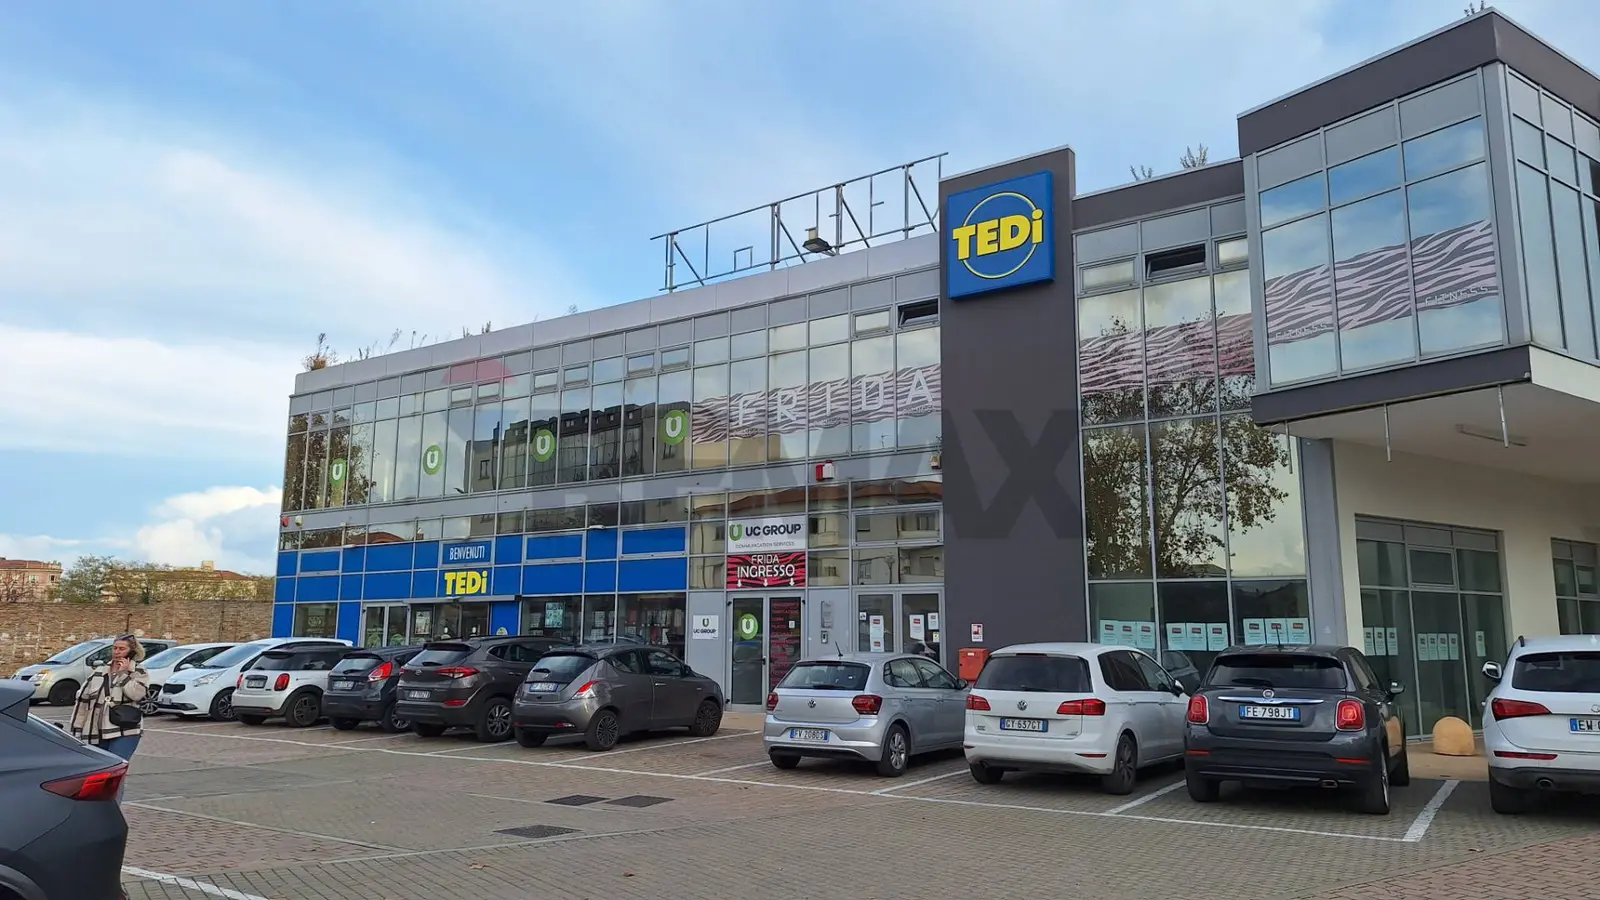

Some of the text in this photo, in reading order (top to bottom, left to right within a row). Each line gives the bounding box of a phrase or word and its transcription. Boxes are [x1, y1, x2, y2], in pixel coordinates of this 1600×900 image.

[952, 209, 1044, 260] TEDi
[1424, 285, 1490, 305] FITNESS
[738, 369, 933, 426] FRIDA
[745, 523, 802, 537] UC GROUP
[449, 545, 485, 560] BENVENUTI
[751, 554, 780, 564] FRIDA
[737, 564, 795, 578] INGRESSO
[444, 571, 488, 596] TEDi
[1246, 706, 1292, 718] FE 798JT
[1578, 719, 1593, 731] EW
